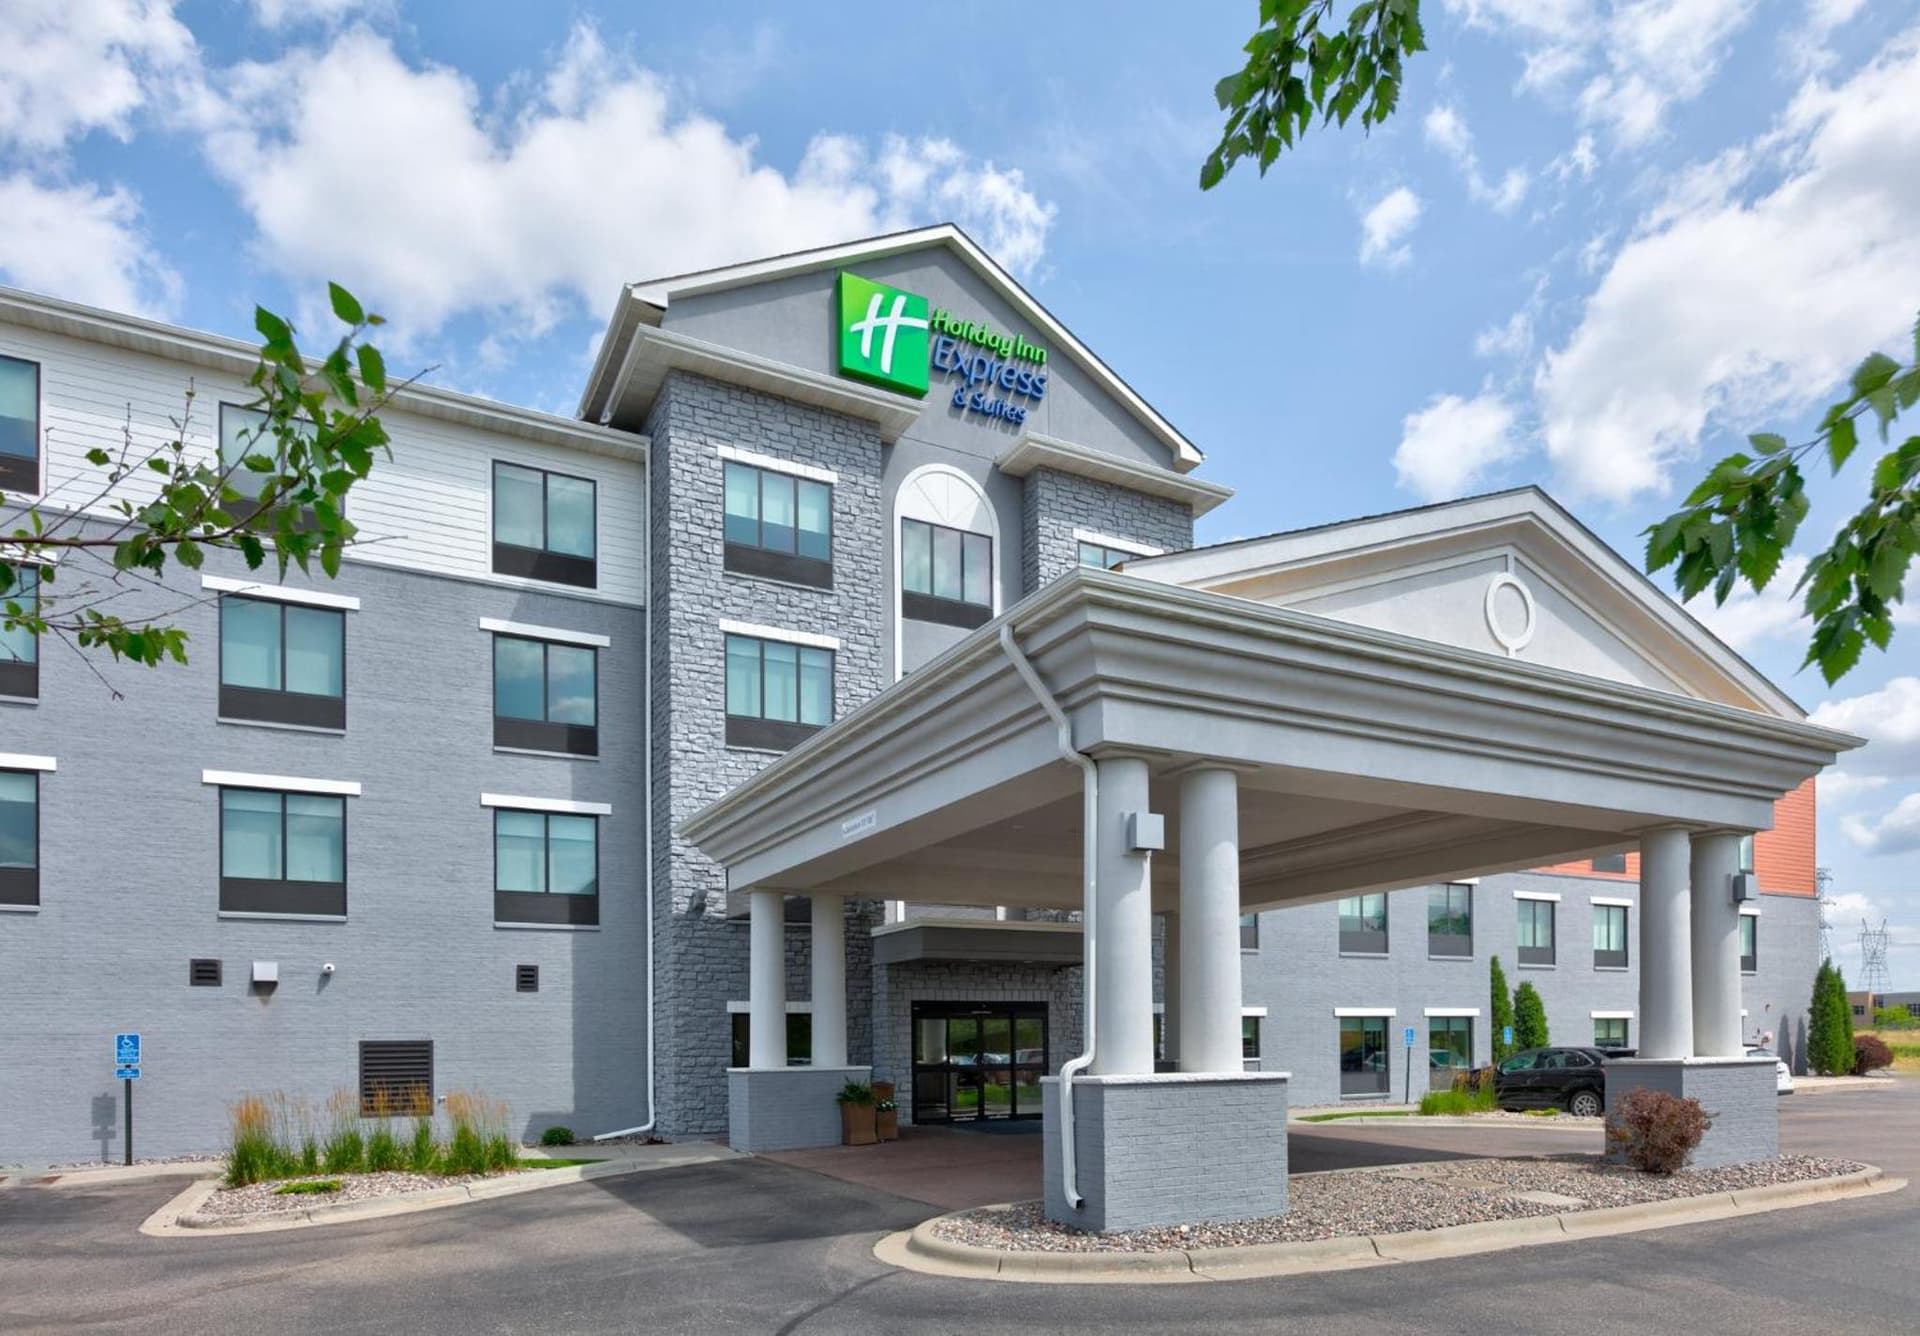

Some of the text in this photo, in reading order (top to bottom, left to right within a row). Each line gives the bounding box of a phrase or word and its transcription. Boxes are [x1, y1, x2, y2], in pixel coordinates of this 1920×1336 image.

[850, 292, 928, 374] H
[932, 308, 1047, 365] Holiday Inn
[934, 335, 1047, 399] Express
[953, 386, 1027, 423] & Suites
